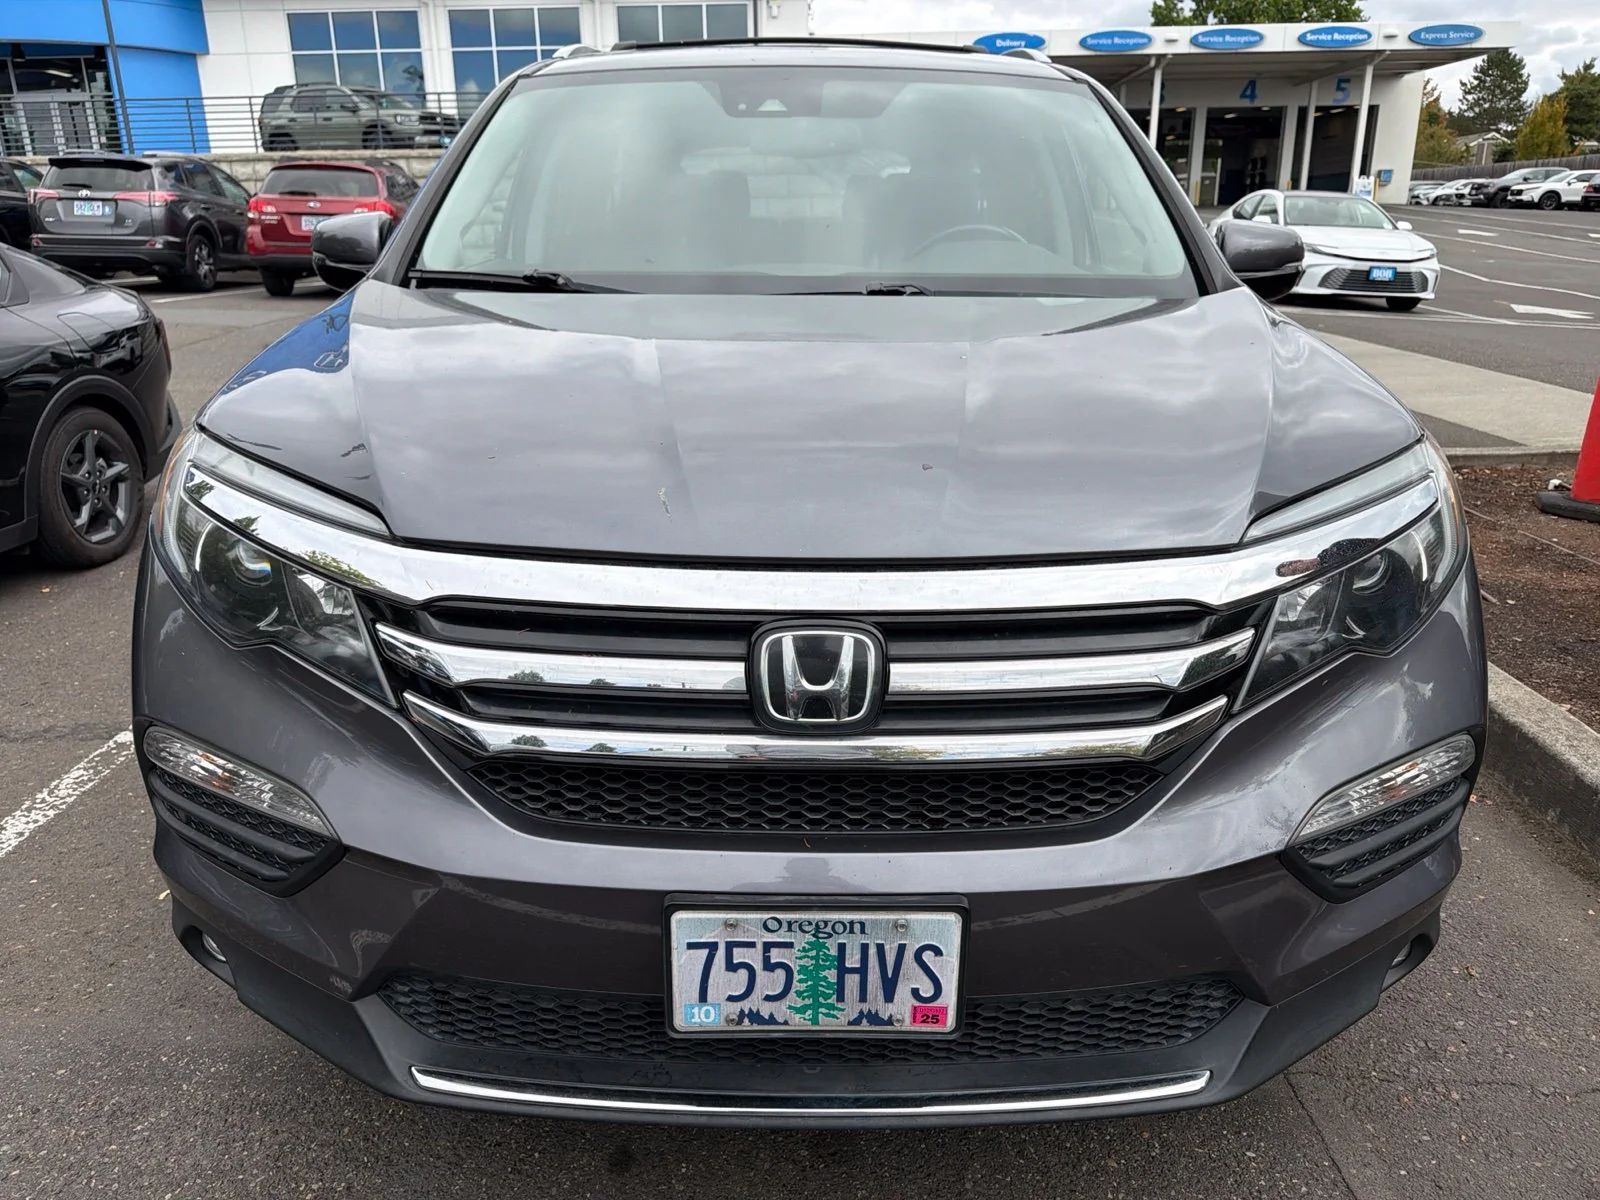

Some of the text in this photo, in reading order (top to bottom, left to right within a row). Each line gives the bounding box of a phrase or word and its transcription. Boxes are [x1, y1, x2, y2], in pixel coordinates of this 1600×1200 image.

[1086, 36, 1149, 45] Service Reception
[1198, 34, 1260, 43] Service Reception
[1305, 32, 1368, 42] Service Reception
[1421, 30, 1475, 40] Express Service
[996, 38, 1026, 48] Delivery
[1239, 79, 1258, 104] 4
[1332, 78, 1352, 104] 5
[762, 916, 869, 940] Oregon
[686, 941, 944, 1004] 755 HVS
[691, 1006, 715, 1023] 10
[920, 1013, 940, 1024] 25
